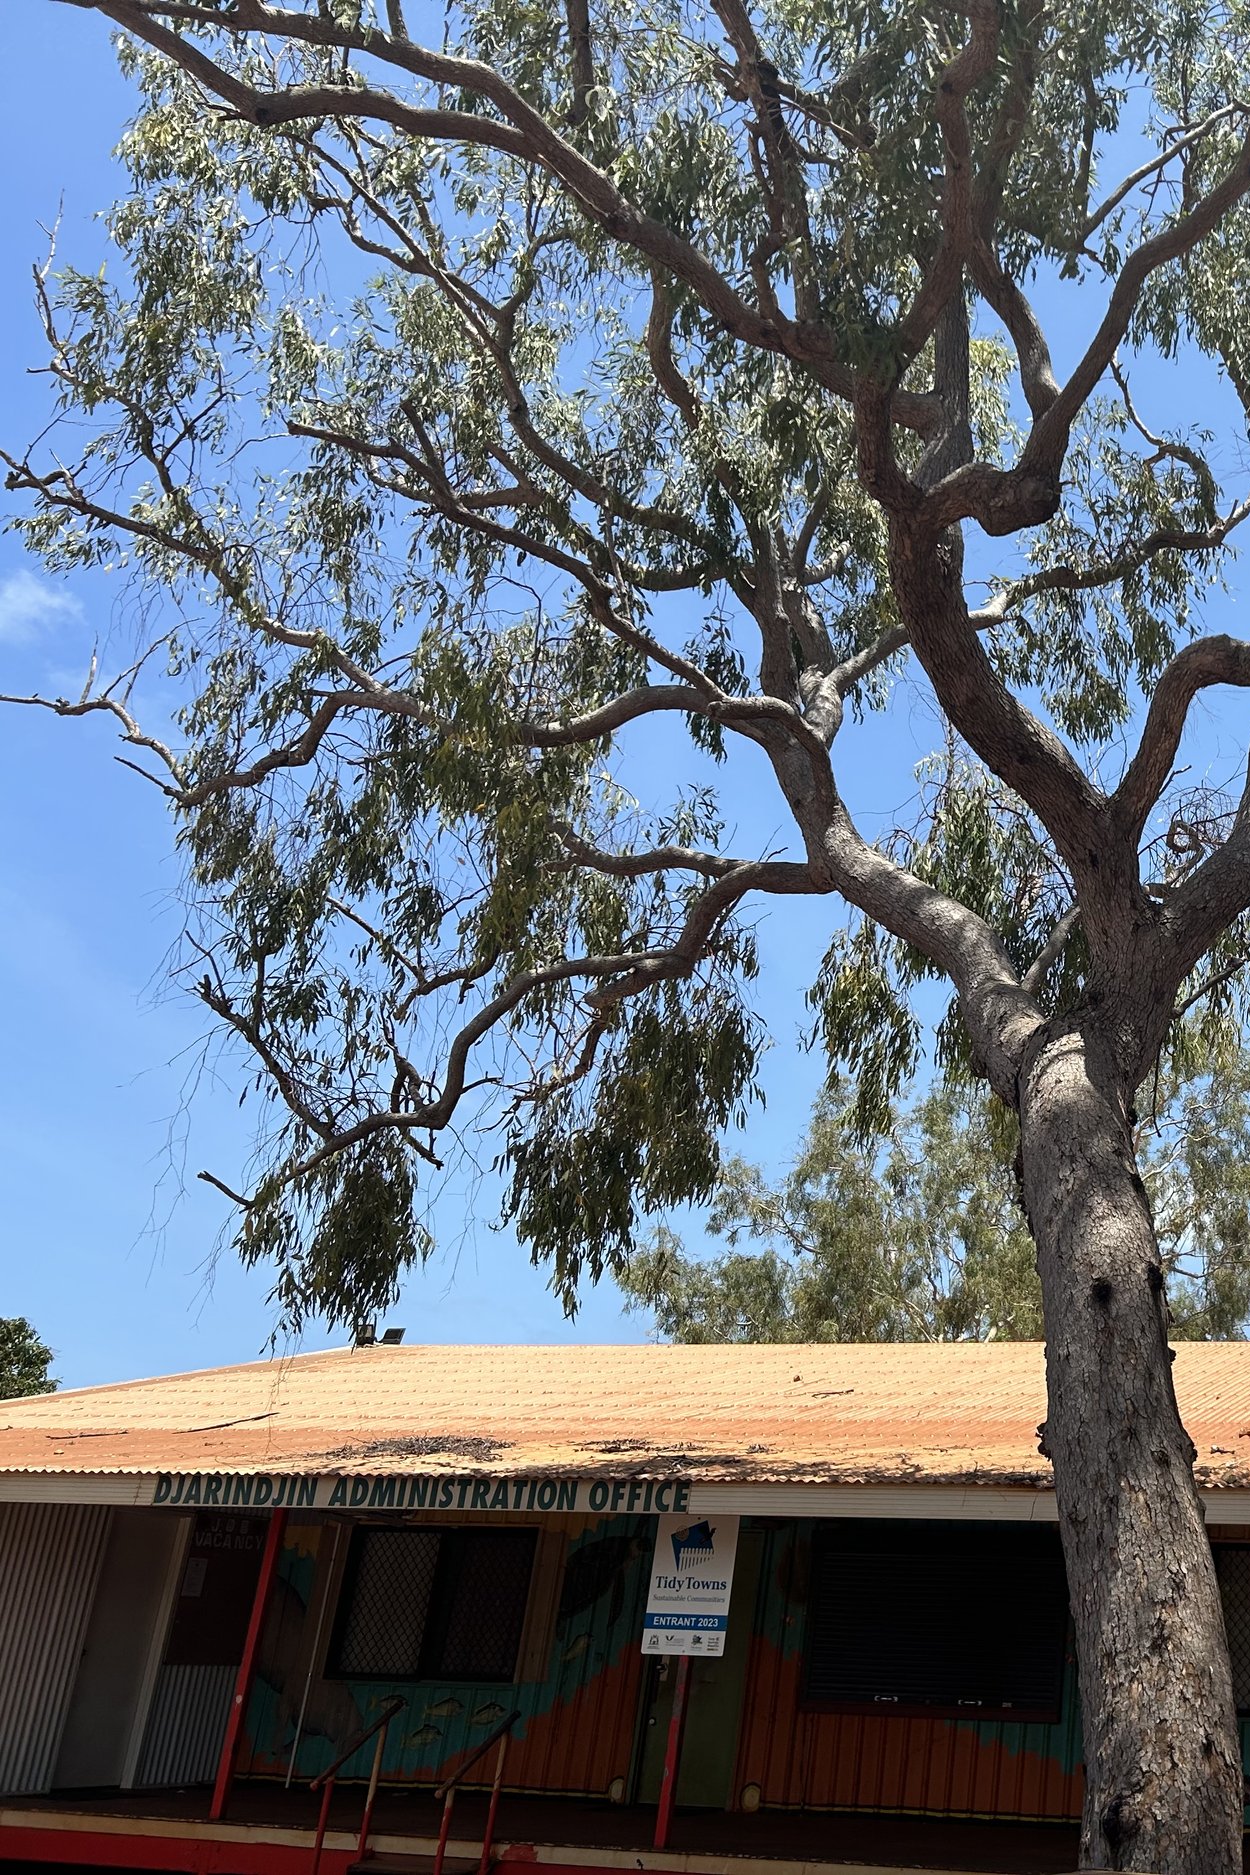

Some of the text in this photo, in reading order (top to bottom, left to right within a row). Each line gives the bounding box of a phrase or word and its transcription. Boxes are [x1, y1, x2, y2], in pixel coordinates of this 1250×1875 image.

[153, 1475, 691, 1513] DJARINDJIN ADMINISTRATION OFFICE
[195, 1532, 264, 1550] VACANCY
[653, 1616, 719, 1627] ENTRANT 2023
